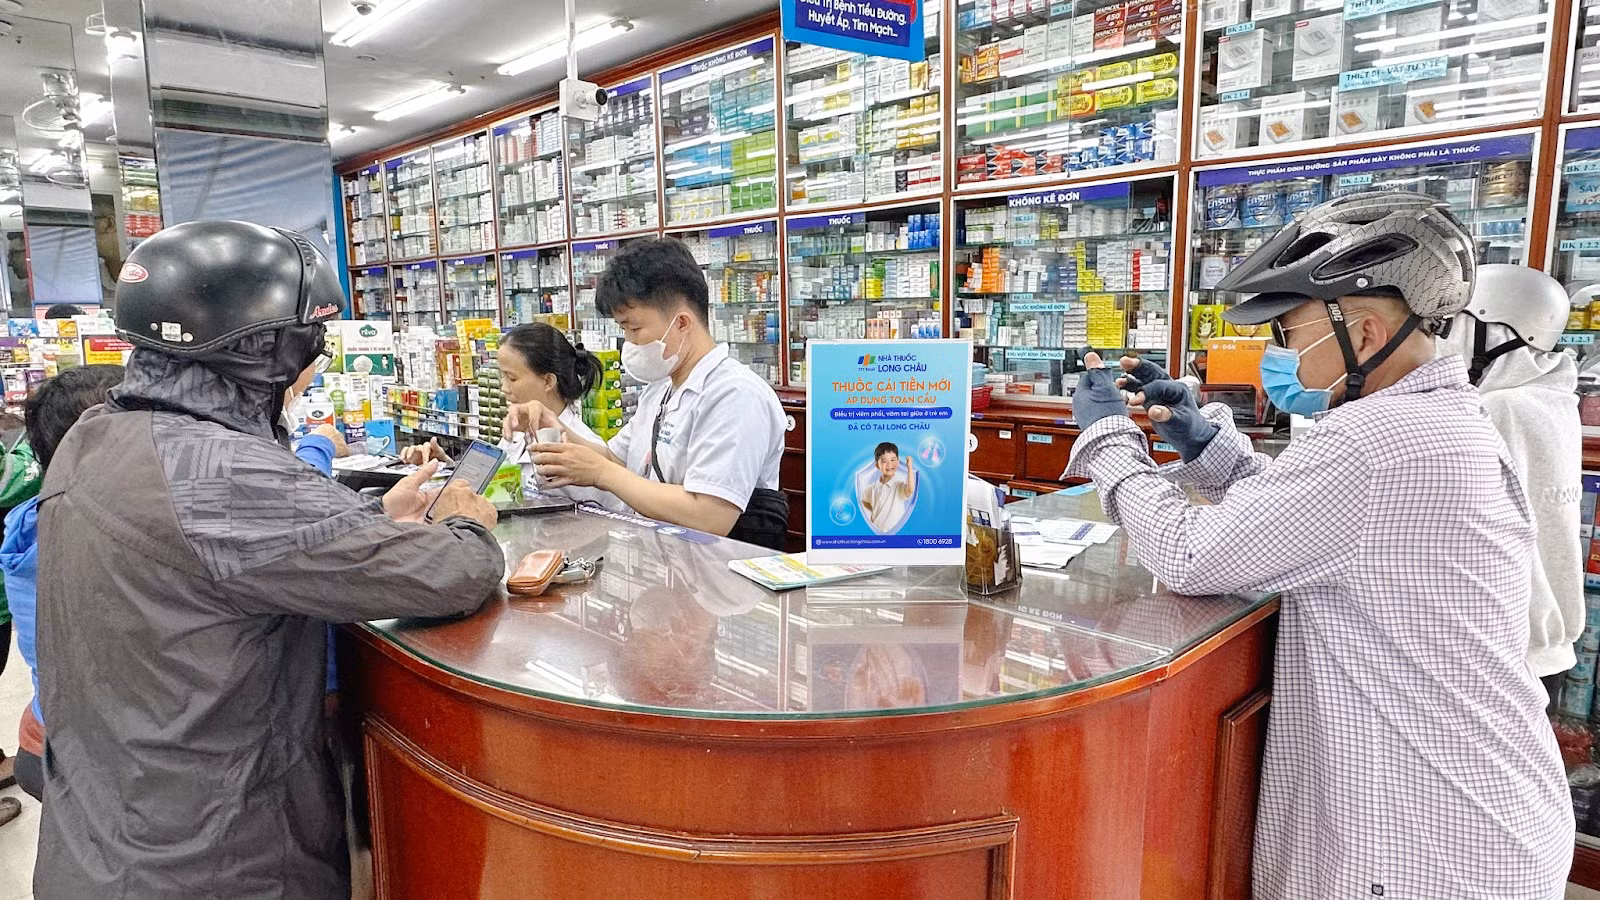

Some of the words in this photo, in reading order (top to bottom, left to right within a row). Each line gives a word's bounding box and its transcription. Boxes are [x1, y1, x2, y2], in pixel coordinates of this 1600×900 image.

[834, 0, 856, 13] Bệnh
[808, 9, 836, 27] Huyết
[852, 19, 868, 32] Tim
[1388, 153, 1416, 162] KHÔNG
[1452, 144, 1481, 154] THUỐC
[1009, 196, 1041, 208] KHÔNG
[1043, 192, 1056, 204] KÊ
[1058, 192, 1080, 202] ĐƠN
[828, 215, 851, 226] THUỐC
[744, 224, 763, 234] THUỐC
[1329, 304, 1344, 322] POC
[878, 354, 892, 362] NHÀ
[894, 352, 916, 362] THUỐC
[878, 364, 902, 372] LONG
[904, 362, 927, 372] CHÂU
[832, 378, 873, 392] THUỐC
[928, 378, 950, 391] MỚI
[846, 394, 858, 404] ÁP
[860, 396, 886, 406] DỤNG
[890, 394, 914, 404] TOÀN
[918, 392, 936, 404] CẦU
[860, 422, 872, 430] CÓ
[874, 424, 884, 432] TẠI
[908, 422, 930, 430] CHÂU
